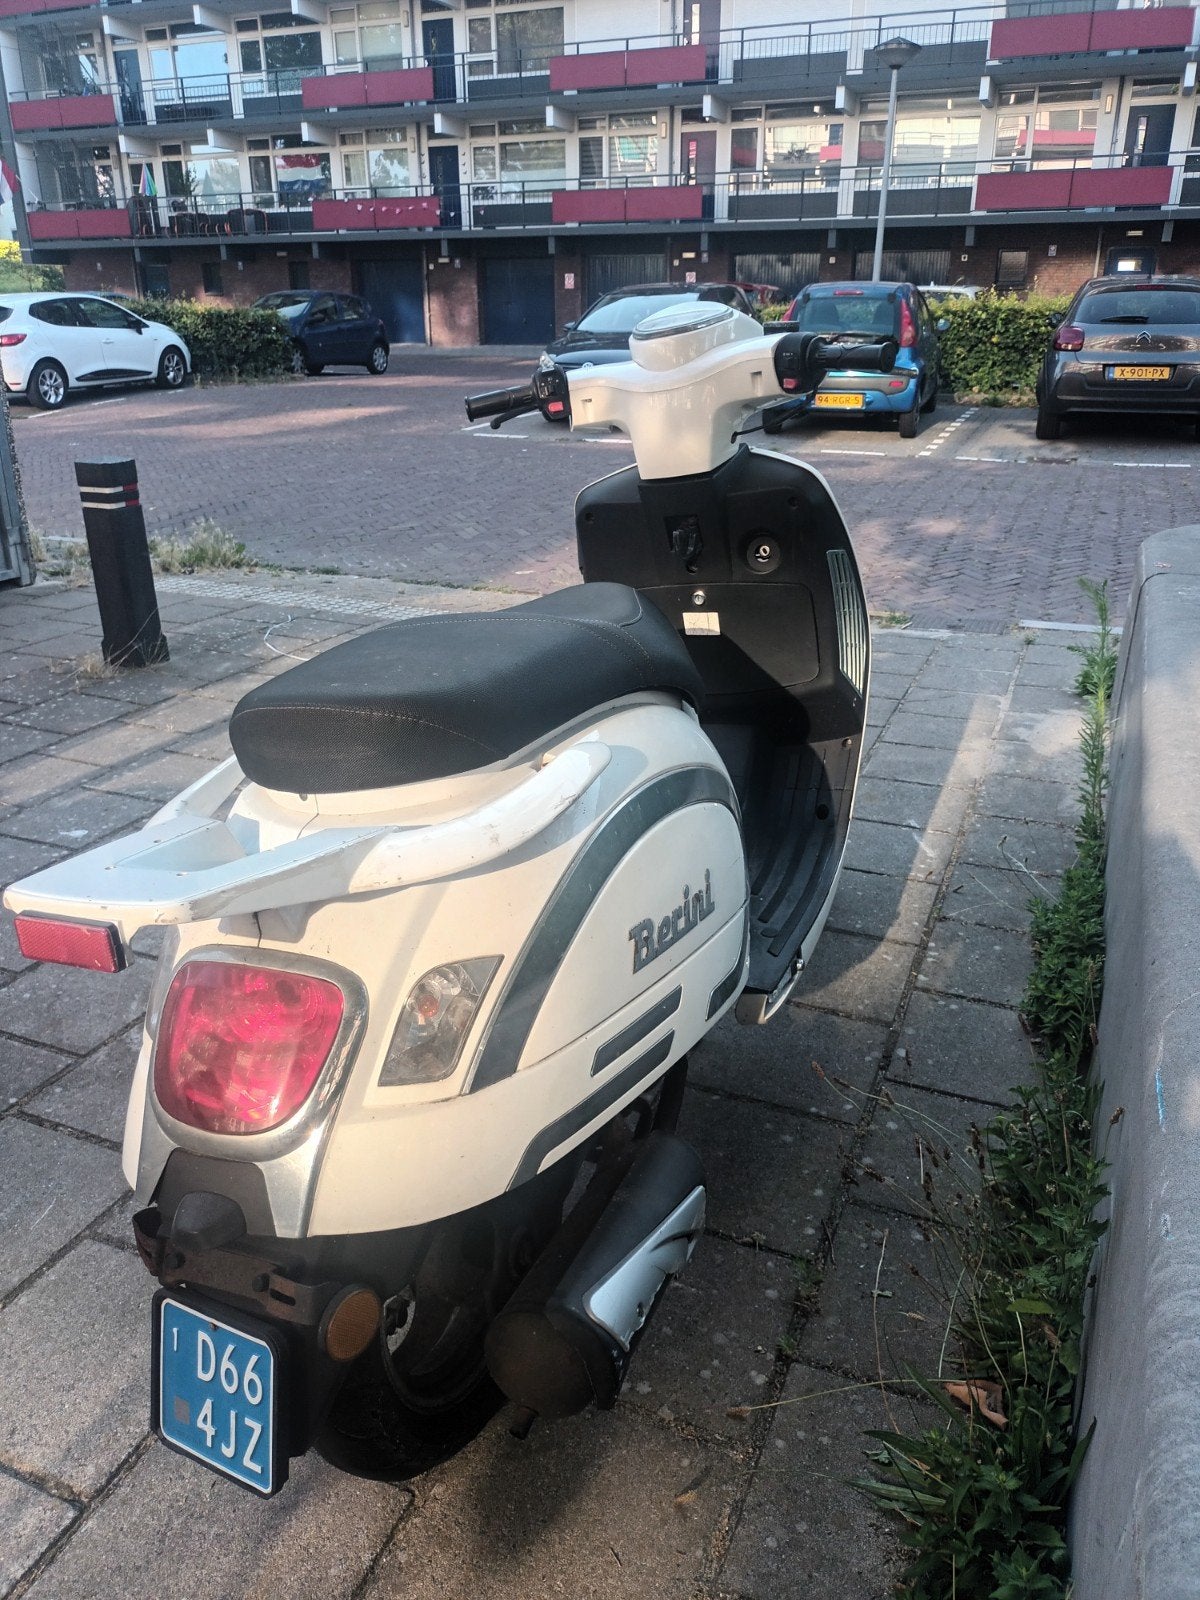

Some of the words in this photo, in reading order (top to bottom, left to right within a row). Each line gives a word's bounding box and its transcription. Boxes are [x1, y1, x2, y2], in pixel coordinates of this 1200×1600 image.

[1119, 368, 1166, 378] X-901-PX
[628, 868, 715, 975] Berini
[196, 1330, 263, 1405] D66
[196, 1398, 263, 1474] 4JZ
